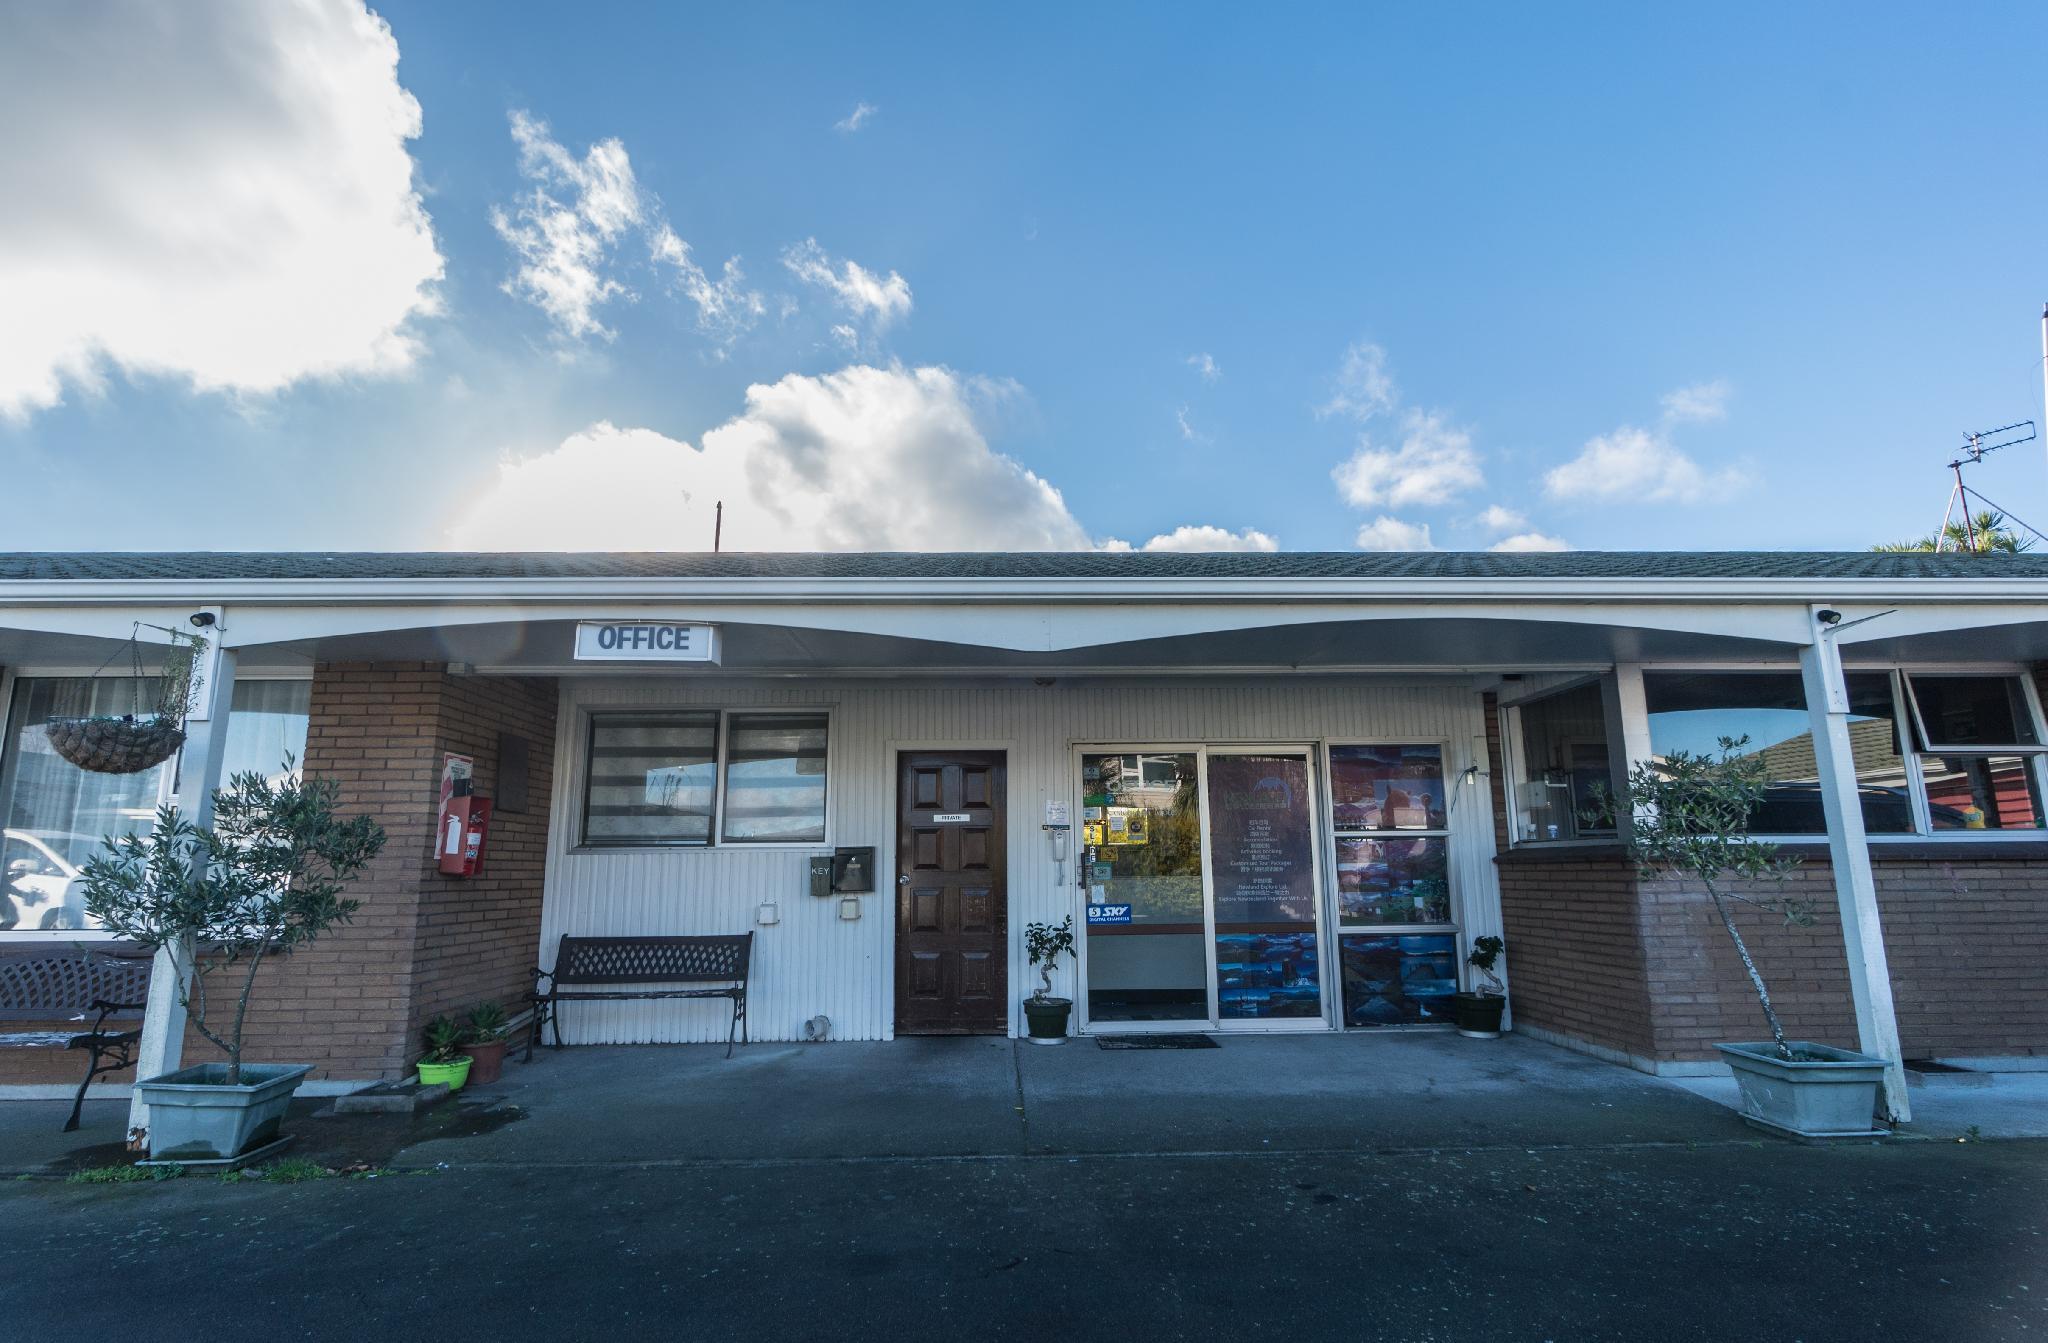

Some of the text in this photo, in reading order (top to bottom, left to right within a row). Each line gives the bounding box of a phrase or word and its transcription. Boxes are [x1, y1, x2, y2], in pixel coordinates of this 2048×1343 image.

[598, 625, 690, 650] OFFICE
[811, 867, 830, 875] KEY
[1091, 906, 1129, 917] 5 SKY
